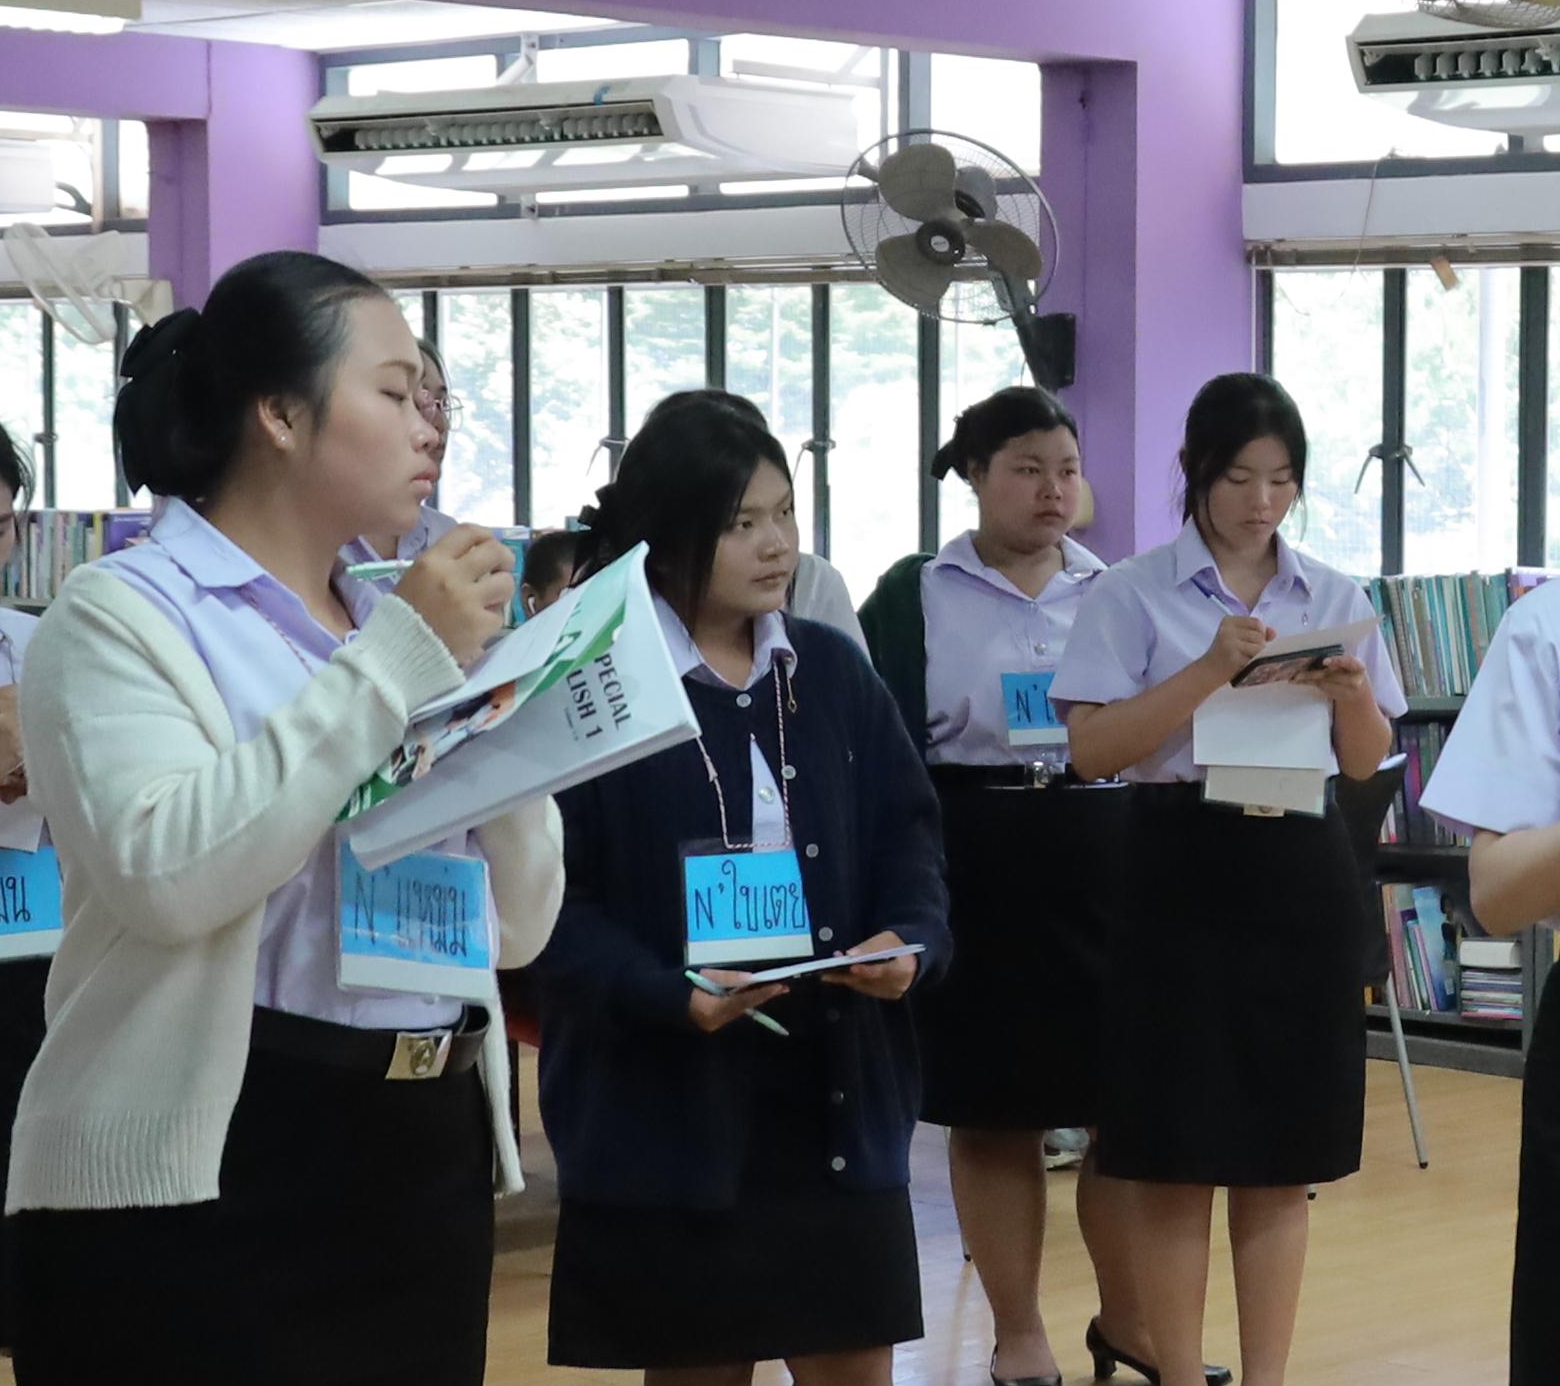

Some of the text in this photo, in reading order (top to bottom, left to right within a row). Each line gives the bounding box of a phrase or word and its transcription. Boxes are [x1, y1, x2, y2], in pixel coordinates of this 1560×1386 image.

[567, 669, 597, 719] LISH
[586, 725, 603, 738] 1
[594, 653, 631, 731] PECIAL
